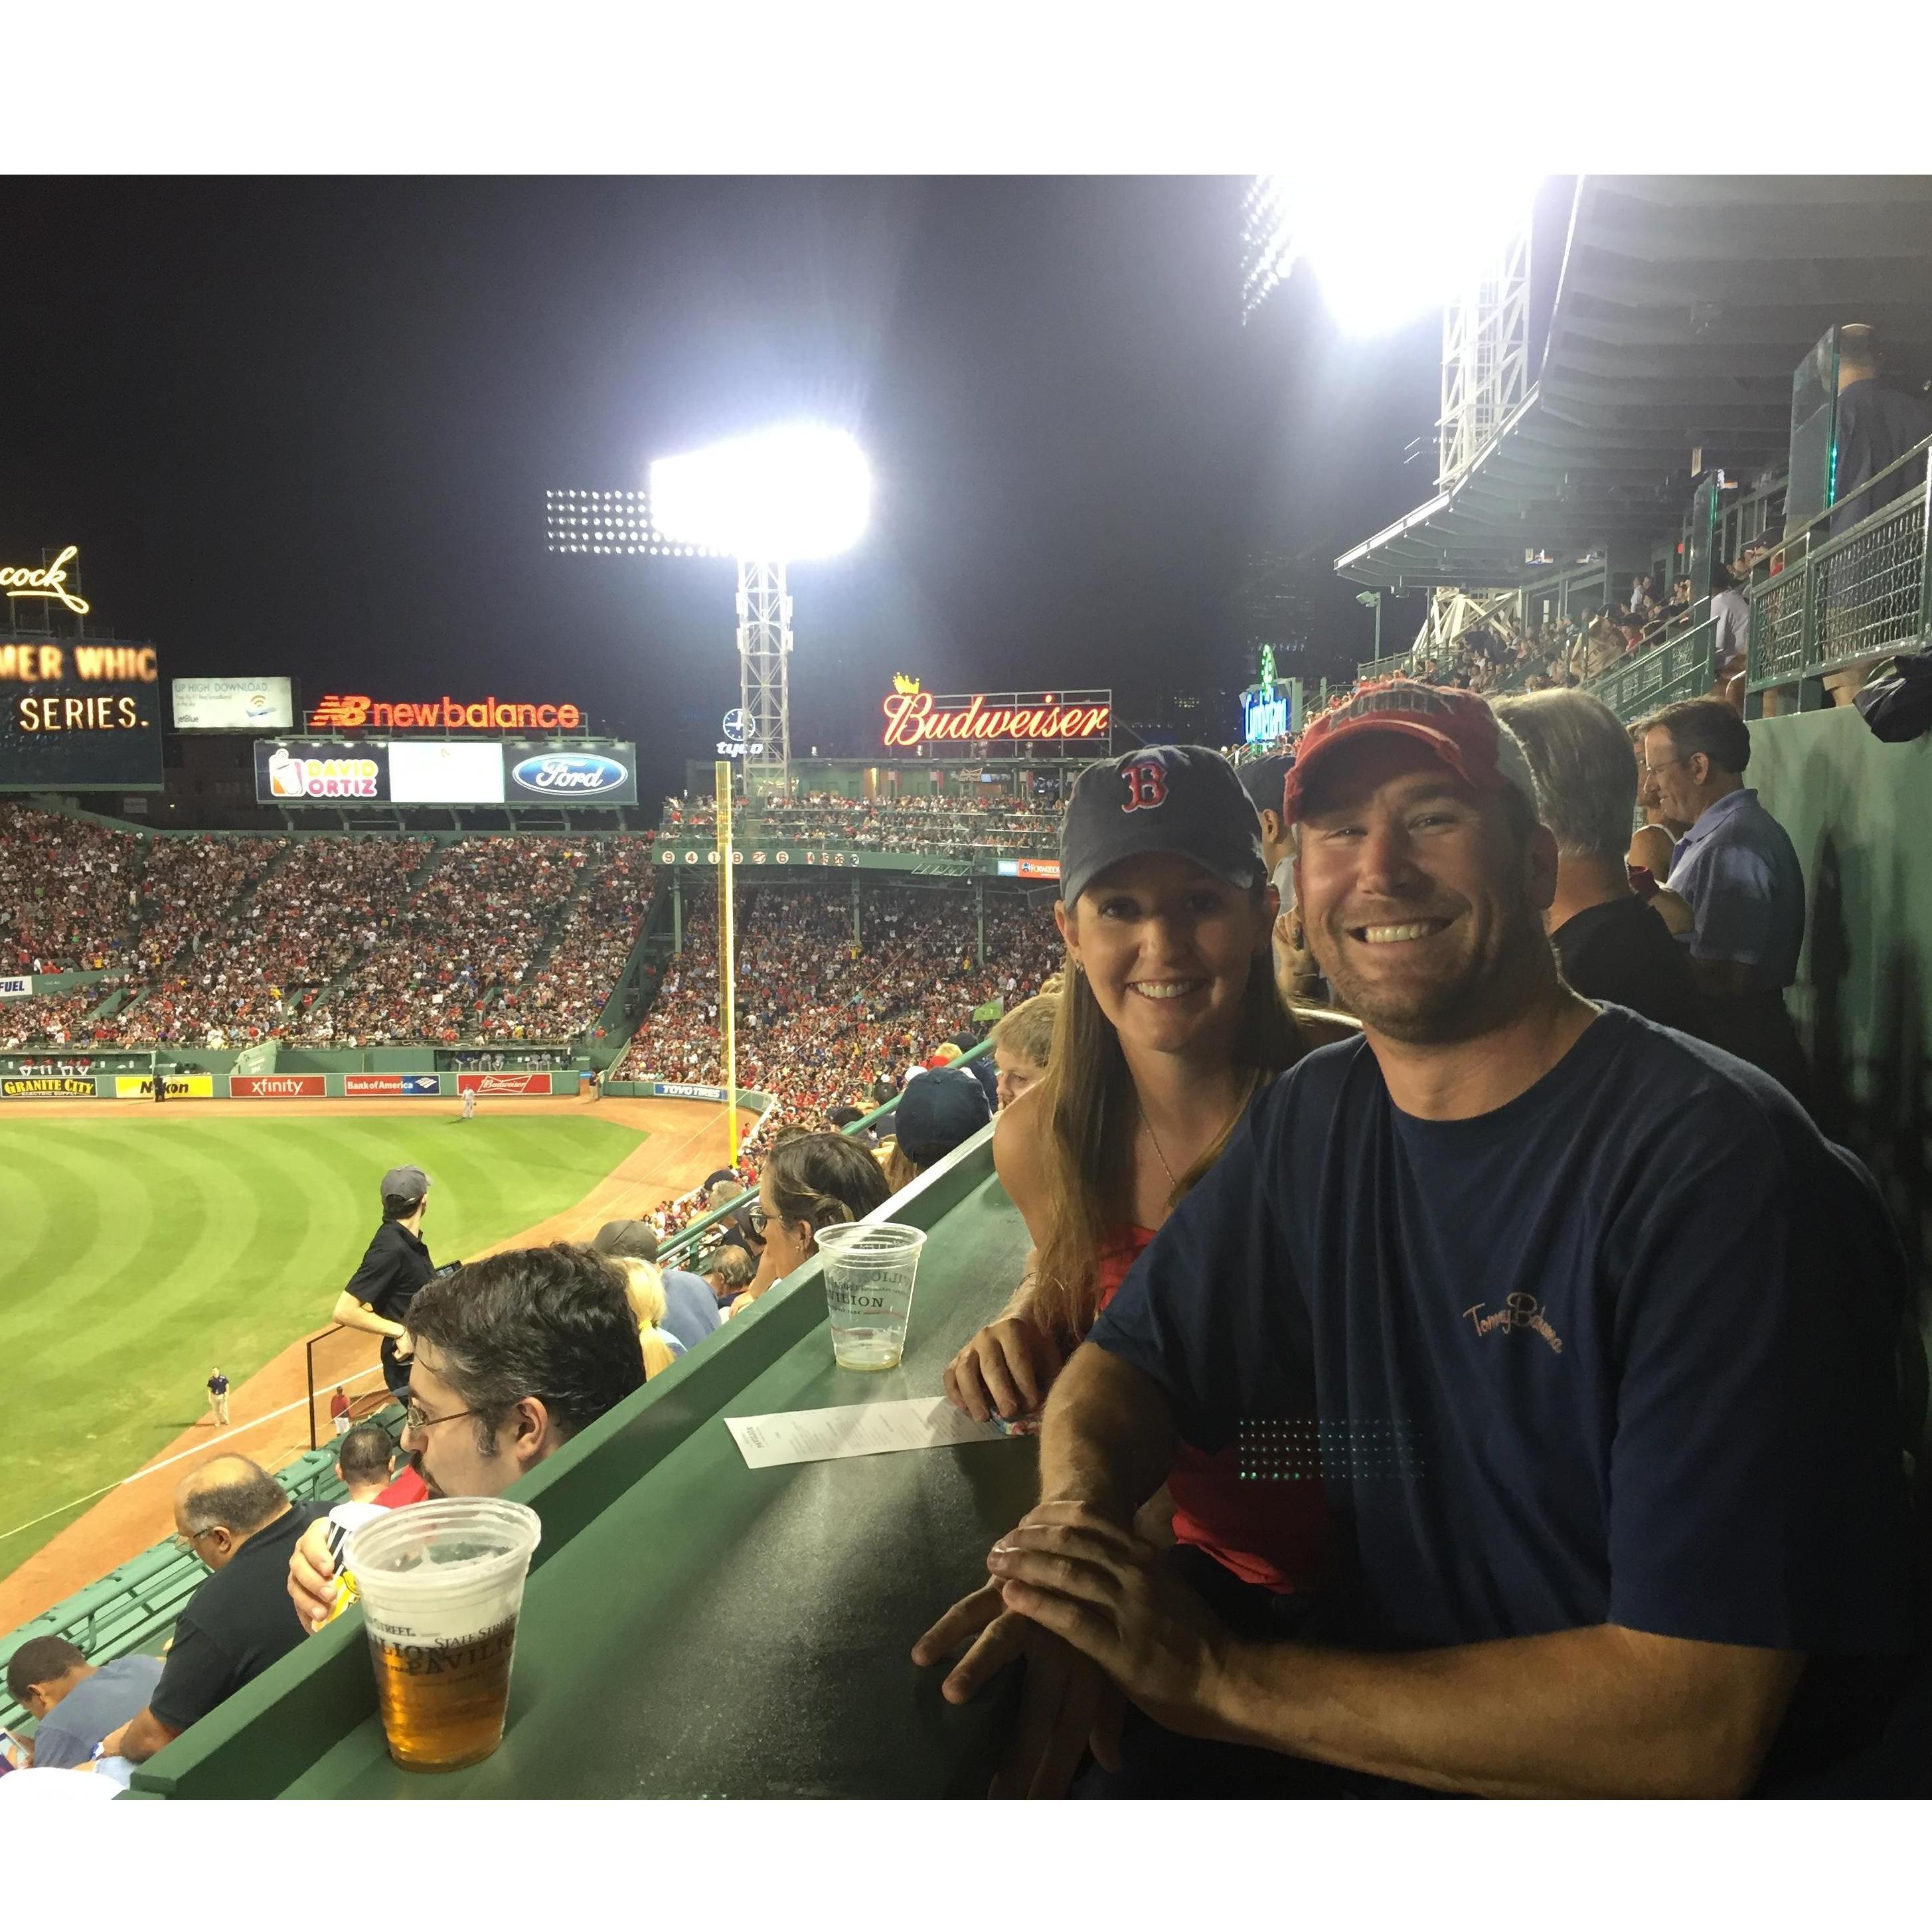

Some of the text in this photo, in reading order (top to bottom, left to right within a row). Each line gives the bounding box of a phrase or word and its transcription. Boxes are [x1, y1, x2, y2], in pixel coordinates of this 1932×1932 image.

[175, 682, 268, 692] UP HIGH DOWNLOAD
[20, 697, 149, 731] SERIES.
[177, 714, 199, 724] jetBlue
[884, 692, 1110, 746] Budweiser
[716, 742, 764, 758] tyco
[308, 762, 374, 777] DAVID
[535, 762, 605, 789] Ford
[308, 779, 374, 795] ORTIZ
[1121, 762, 1169, 813] B
[665, 852, 673, 862] 9
[687, 853, 694, 862] 4
[733, 853, 741, 862] 8
[752, 853, 766, 863] 27
[779, 852, 787, 862] 6
[0, 980, 25, 993] FUEL
[4, 1078, 94, 1095] GRANITE CITY
[140, 1081, 189, 1093] Nkon
[252, 1078, 303, 1095] xfinity
[347, 1081, 413, 1089] Bank of America
[481, 1078, 526, 1089] Budweiser
[663, 1085, 720, 1098] TOYO TIRES
